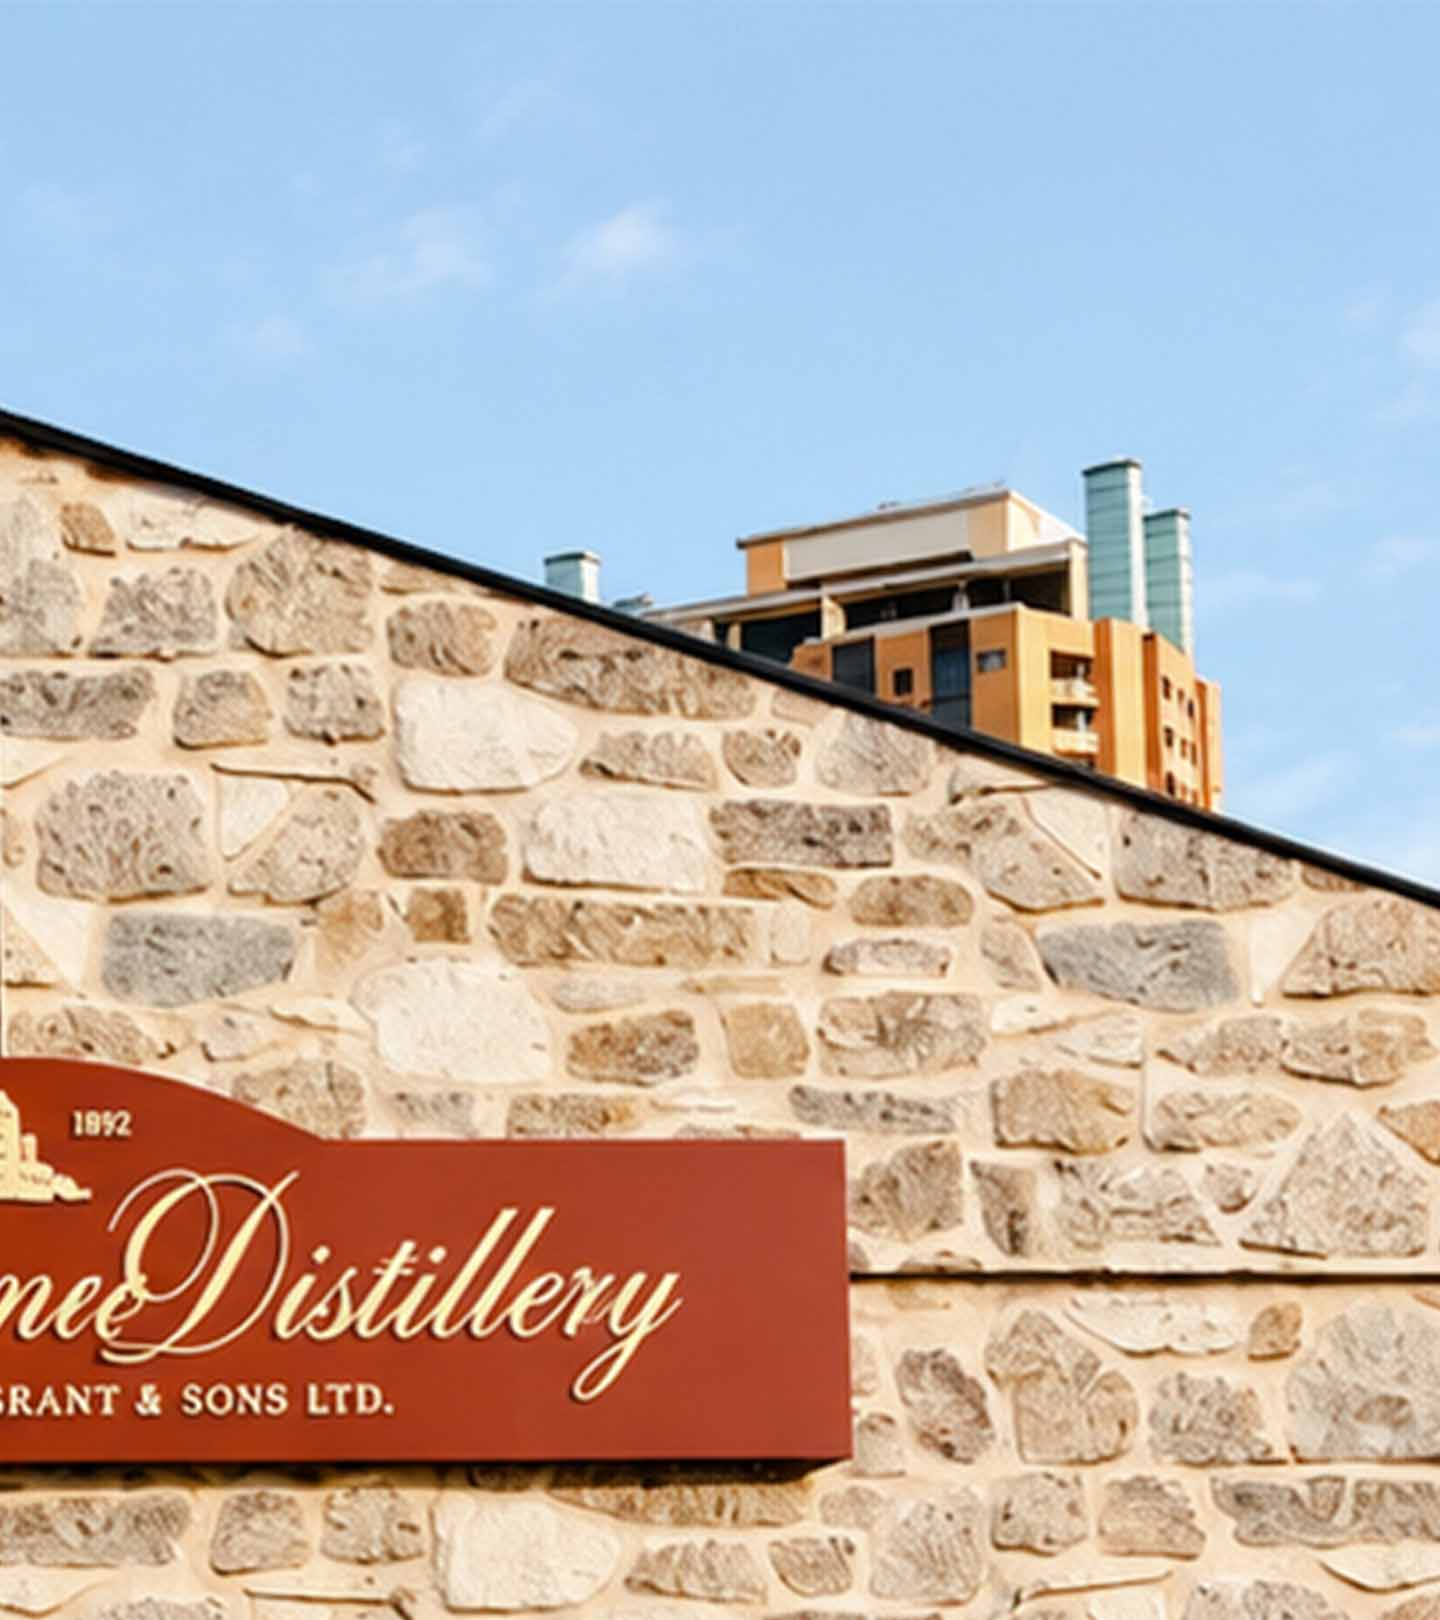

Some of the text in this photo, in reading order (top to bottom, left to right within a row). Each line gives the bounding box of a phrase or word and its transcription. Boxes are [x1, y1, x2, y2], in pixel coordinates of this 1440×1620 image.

[73, 1109, 132, 1137] 1892
[101, 1168, 682, 1402] Distillery
[134, 1382, 163, 1416] &
[181, 1382, 290, 1416] SONS
[307, 1382, 395, 1415] LTD.
